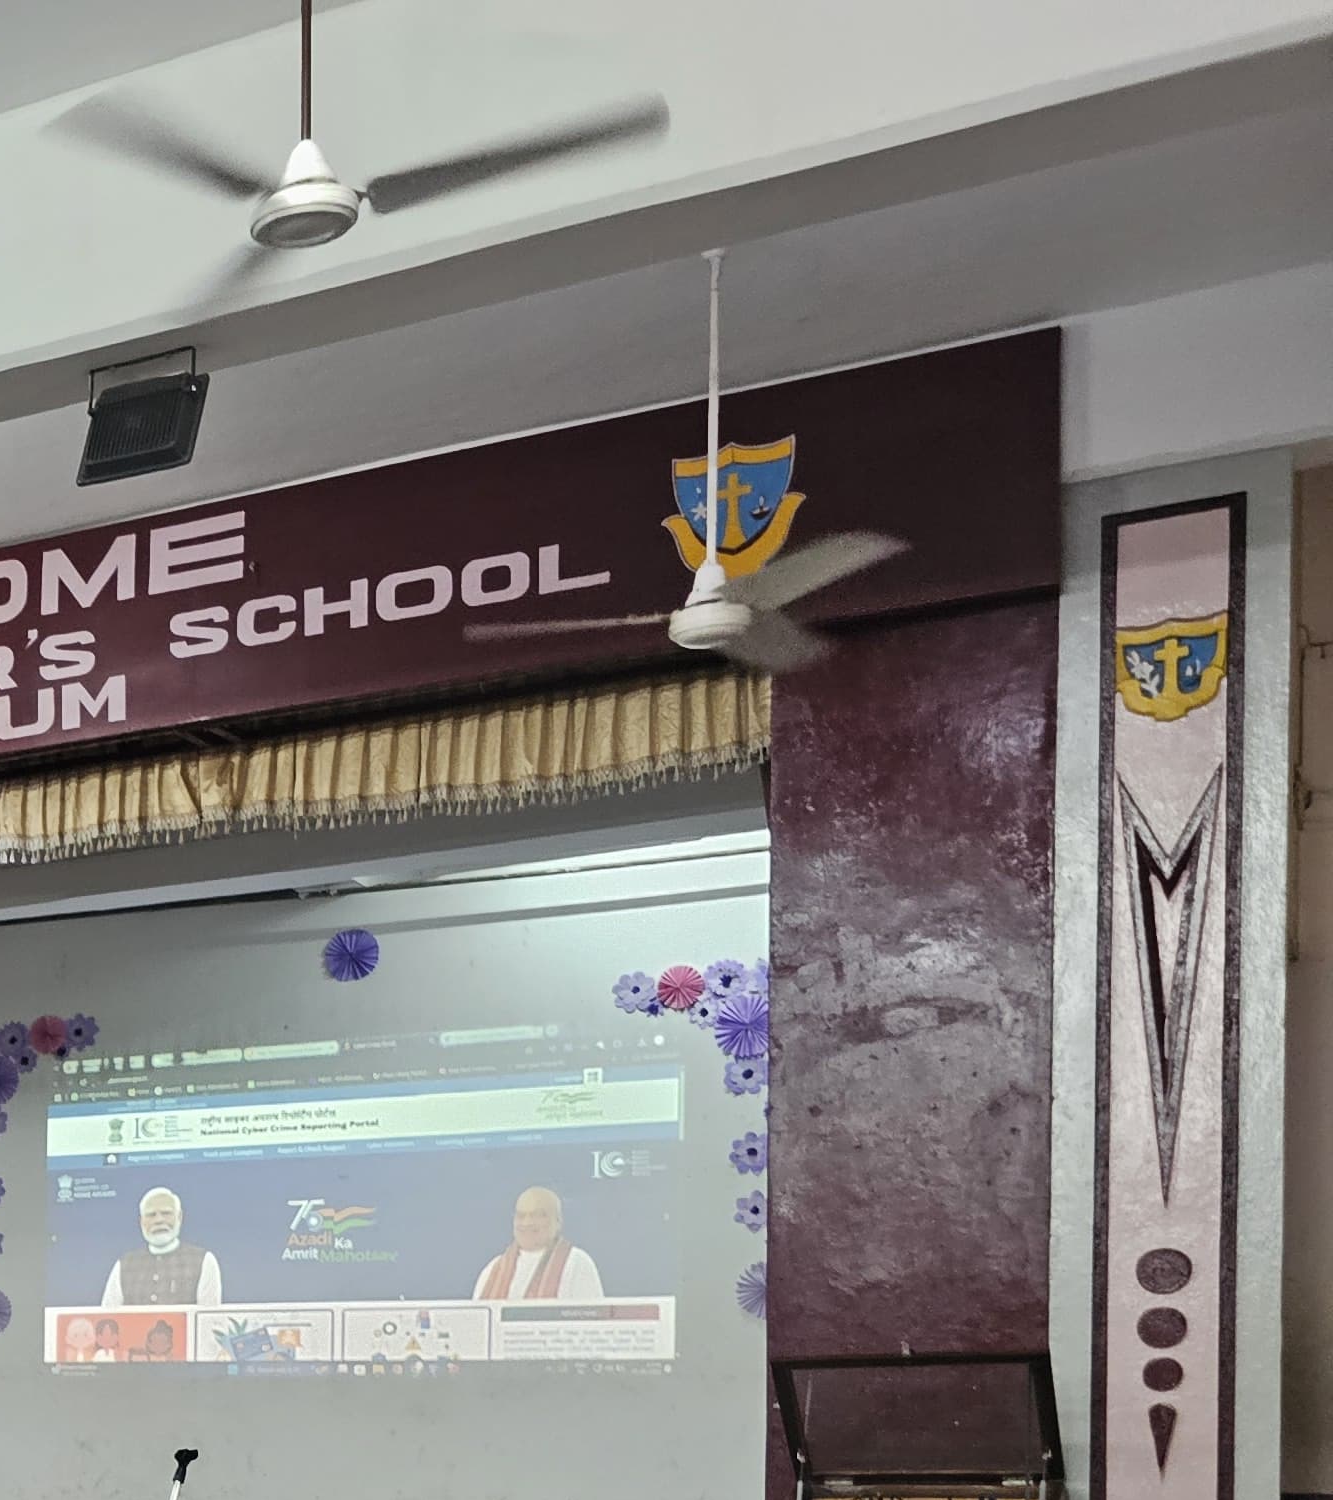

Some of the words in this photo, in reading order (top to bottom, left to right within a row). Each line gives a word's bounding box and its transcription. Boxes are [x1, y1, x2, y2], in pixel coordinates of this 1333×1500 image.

[169, 543, 611, 659] SCHOOL
[287, 1229, 333, 1247] Azadi
[334, 1236, 354, 1250] Ka
[281, 1245, 319, 1261] Amrit
